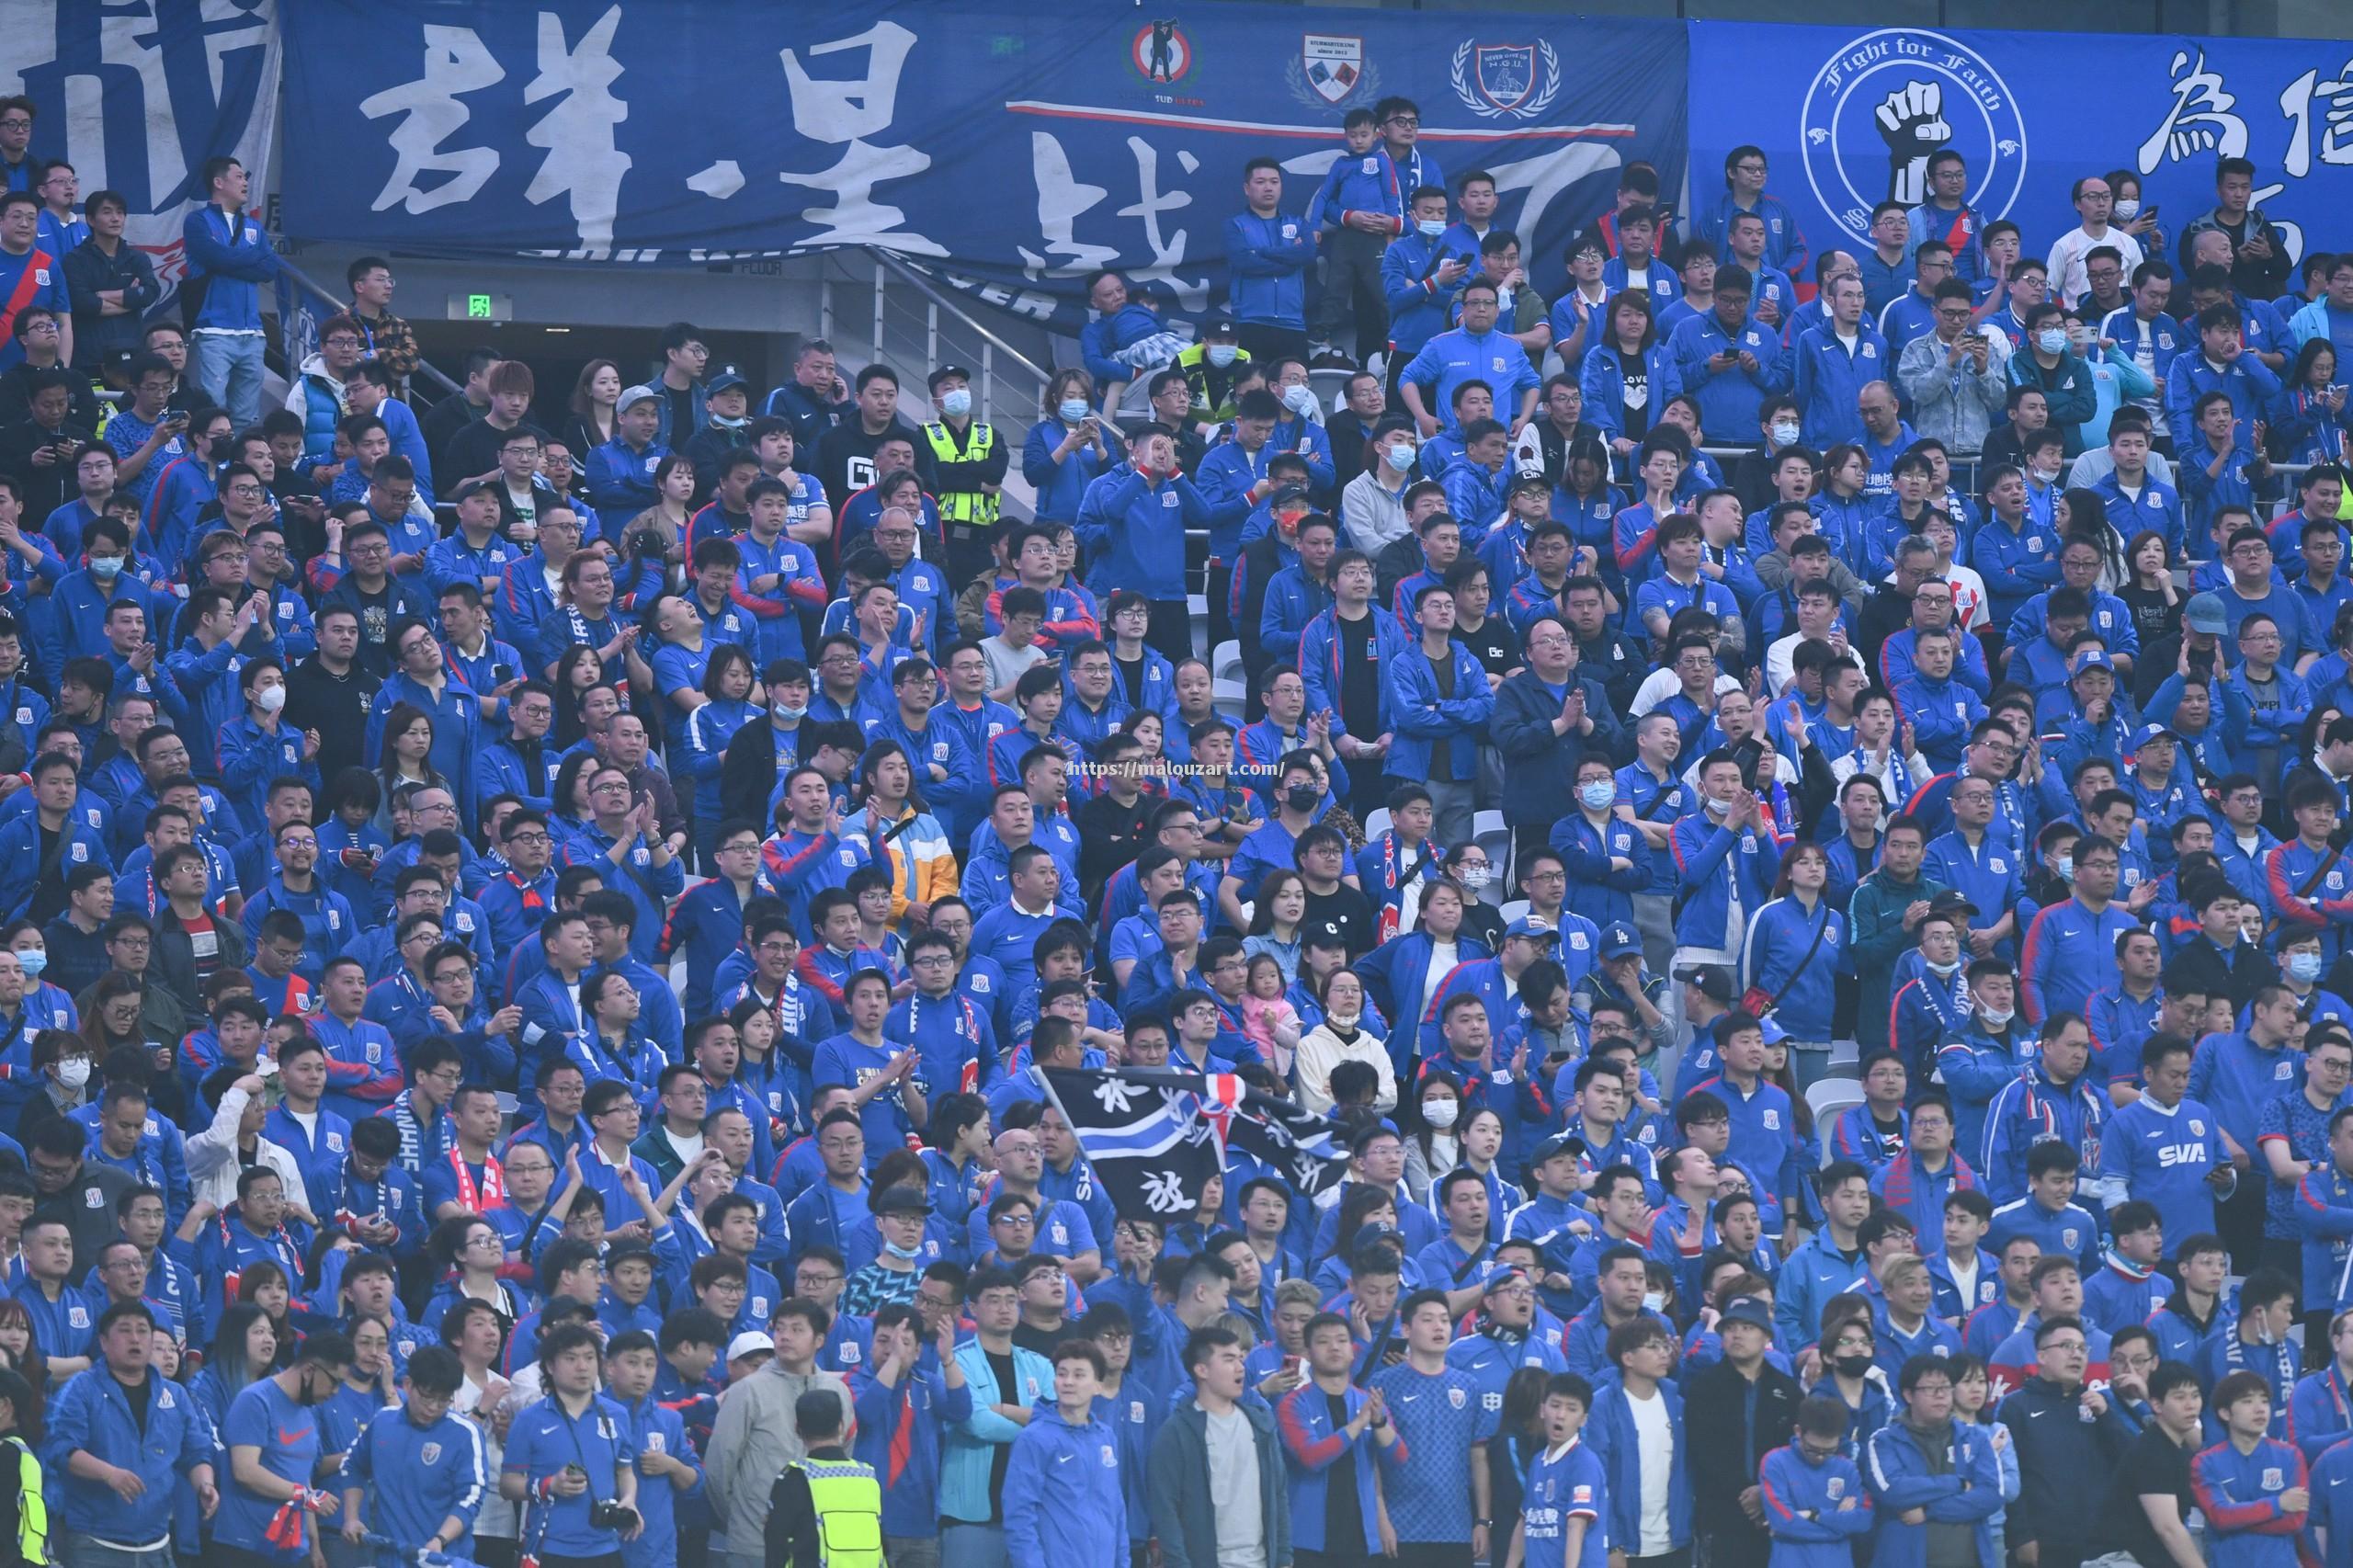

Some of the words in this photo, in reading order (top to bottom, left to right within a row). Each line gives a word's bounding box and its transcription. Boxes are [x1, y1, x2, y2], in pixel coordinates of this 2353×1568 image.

[1824, 39, 1889, 97] Fight
[1896, 38, 1933, 57] for
[1938, 53, 2001, 111] Faith
[1615, 928, 1630, 944] LA
[2157, 1142, 2207, 1168] SVA
